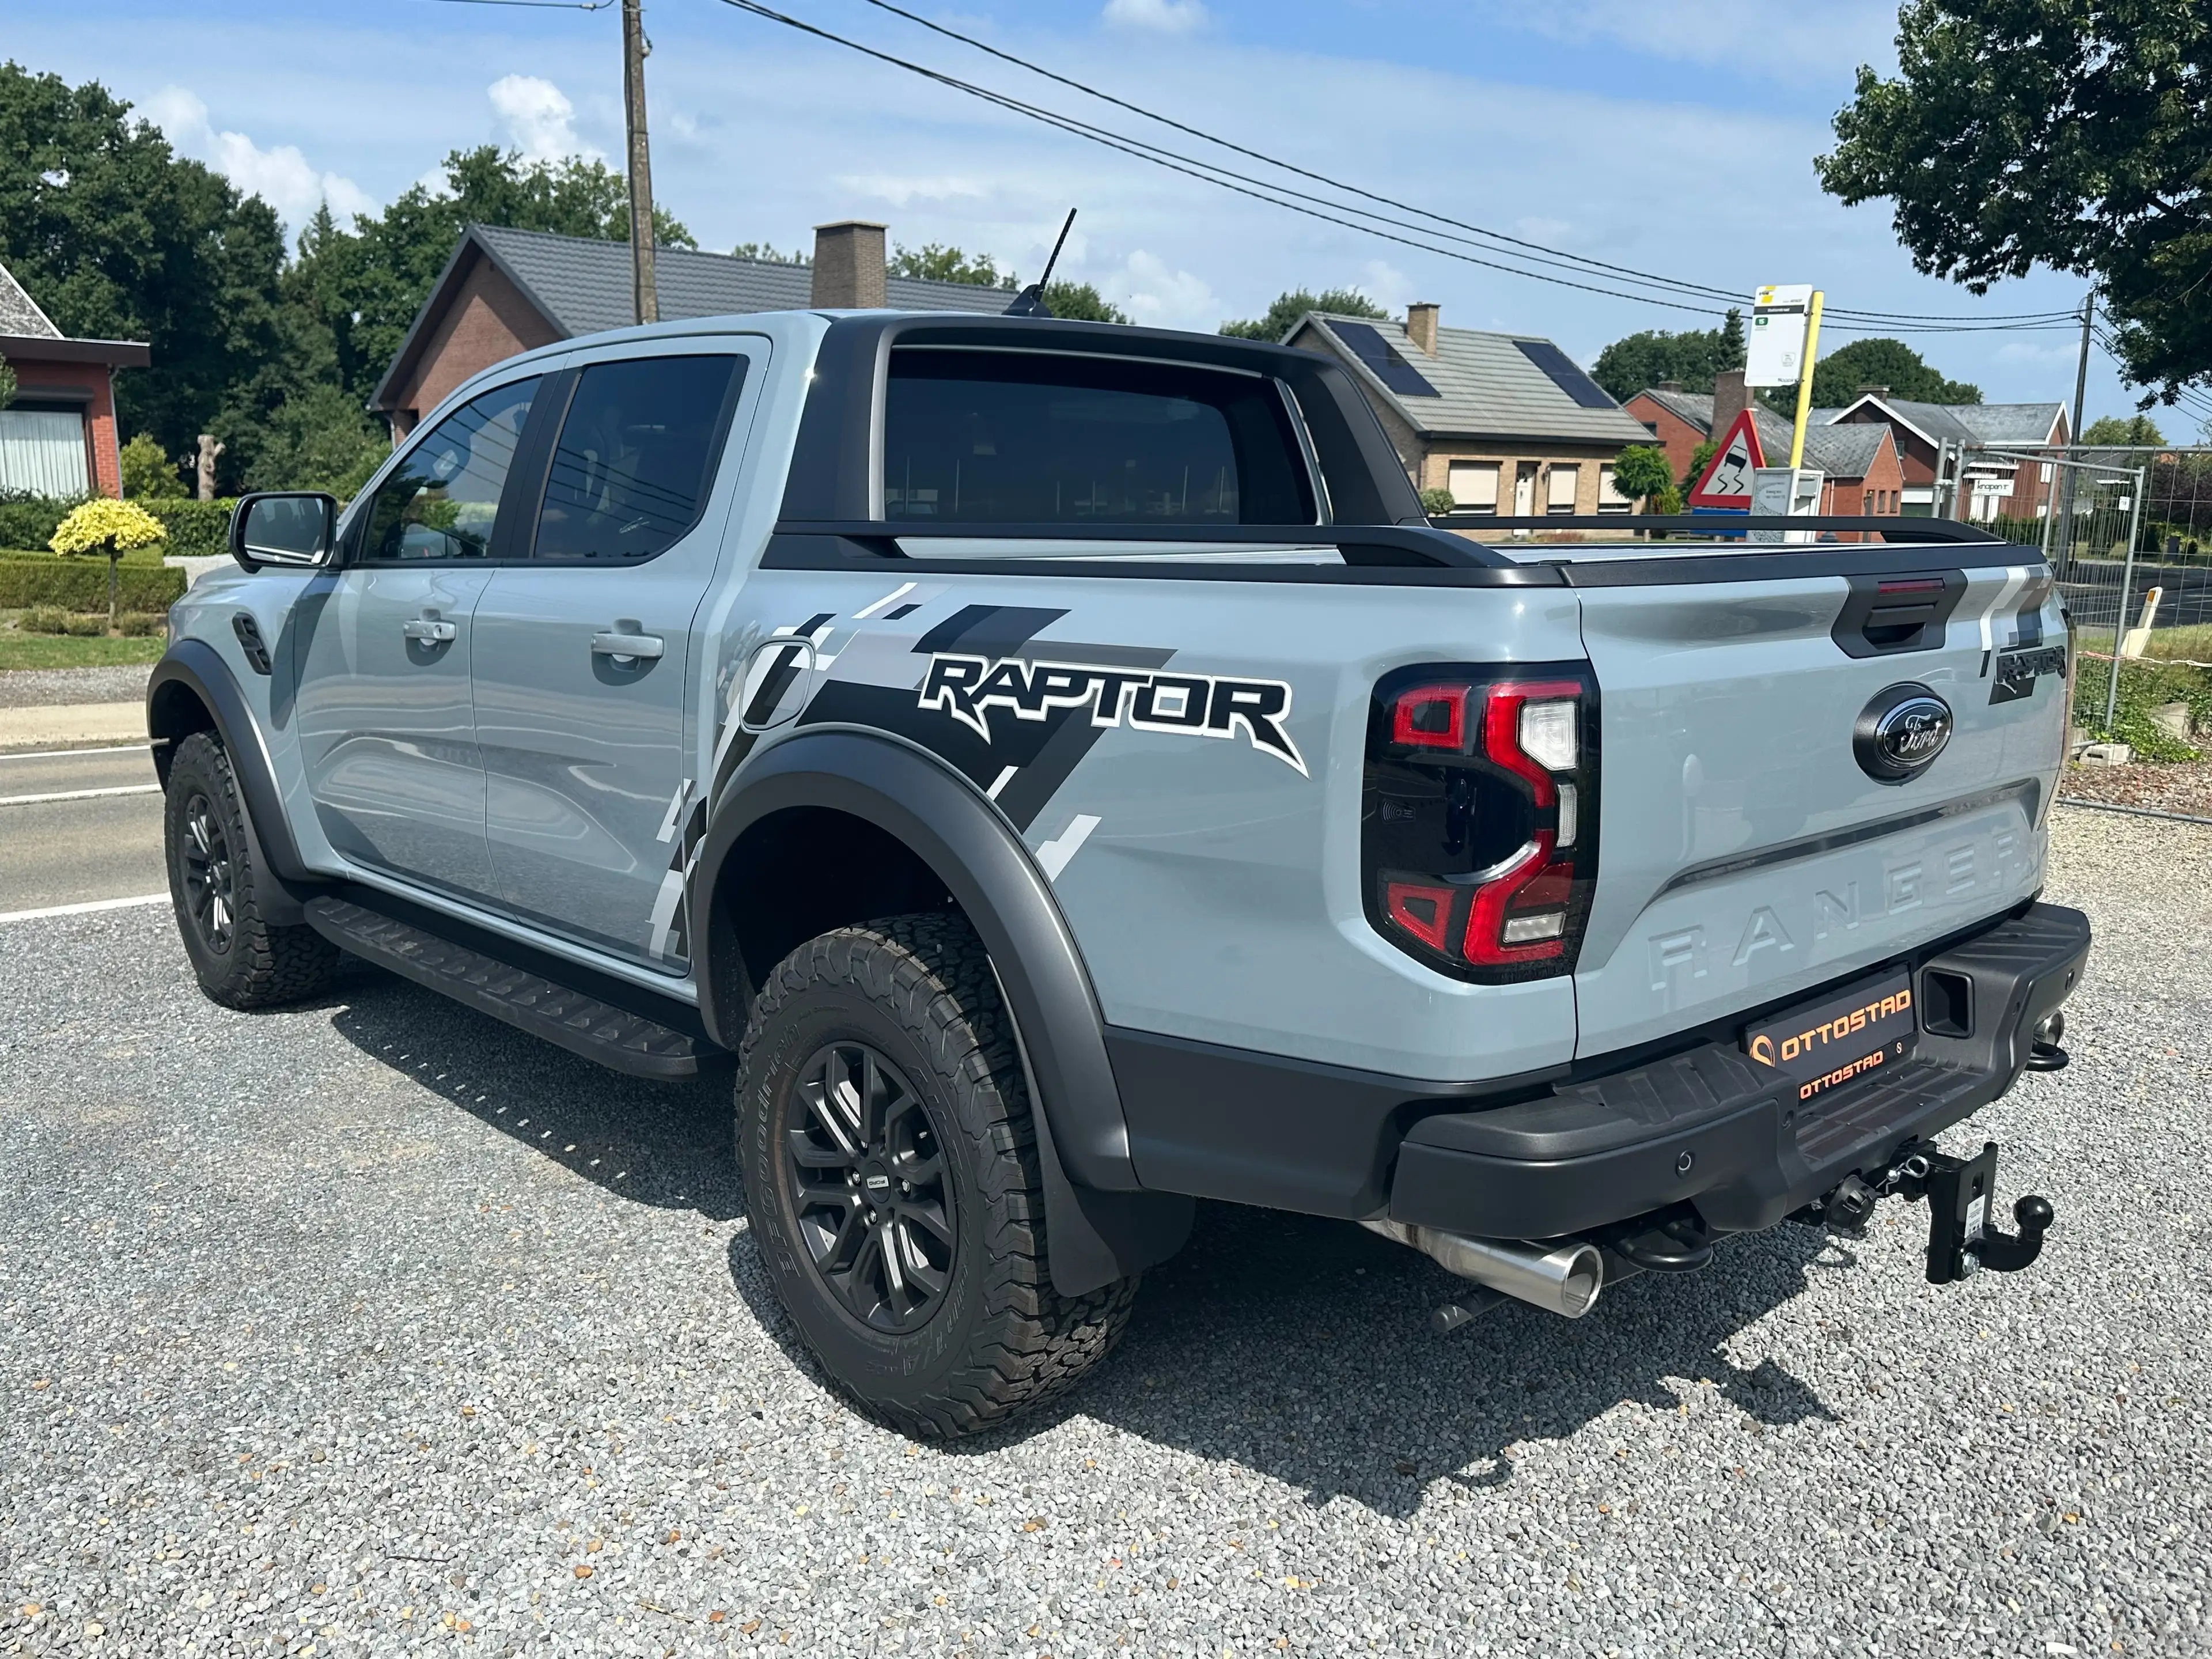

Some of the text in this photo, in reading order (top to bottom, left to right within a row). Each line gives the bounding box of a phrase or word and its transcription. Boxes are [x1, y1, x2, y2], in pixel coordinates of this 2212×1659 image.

[1995, 645, 2066, 694] RAPTOR
[917, 652, 1312, 780] RAPTOR
[1900, 714, 1941, 753] Ford
[1781, 989, 1911, 1061] OTTOSTAD
[1800, 1051, 1883, 1100] OTTOSTAD
[757, 1024, 801, 1278] BFGoodrich
